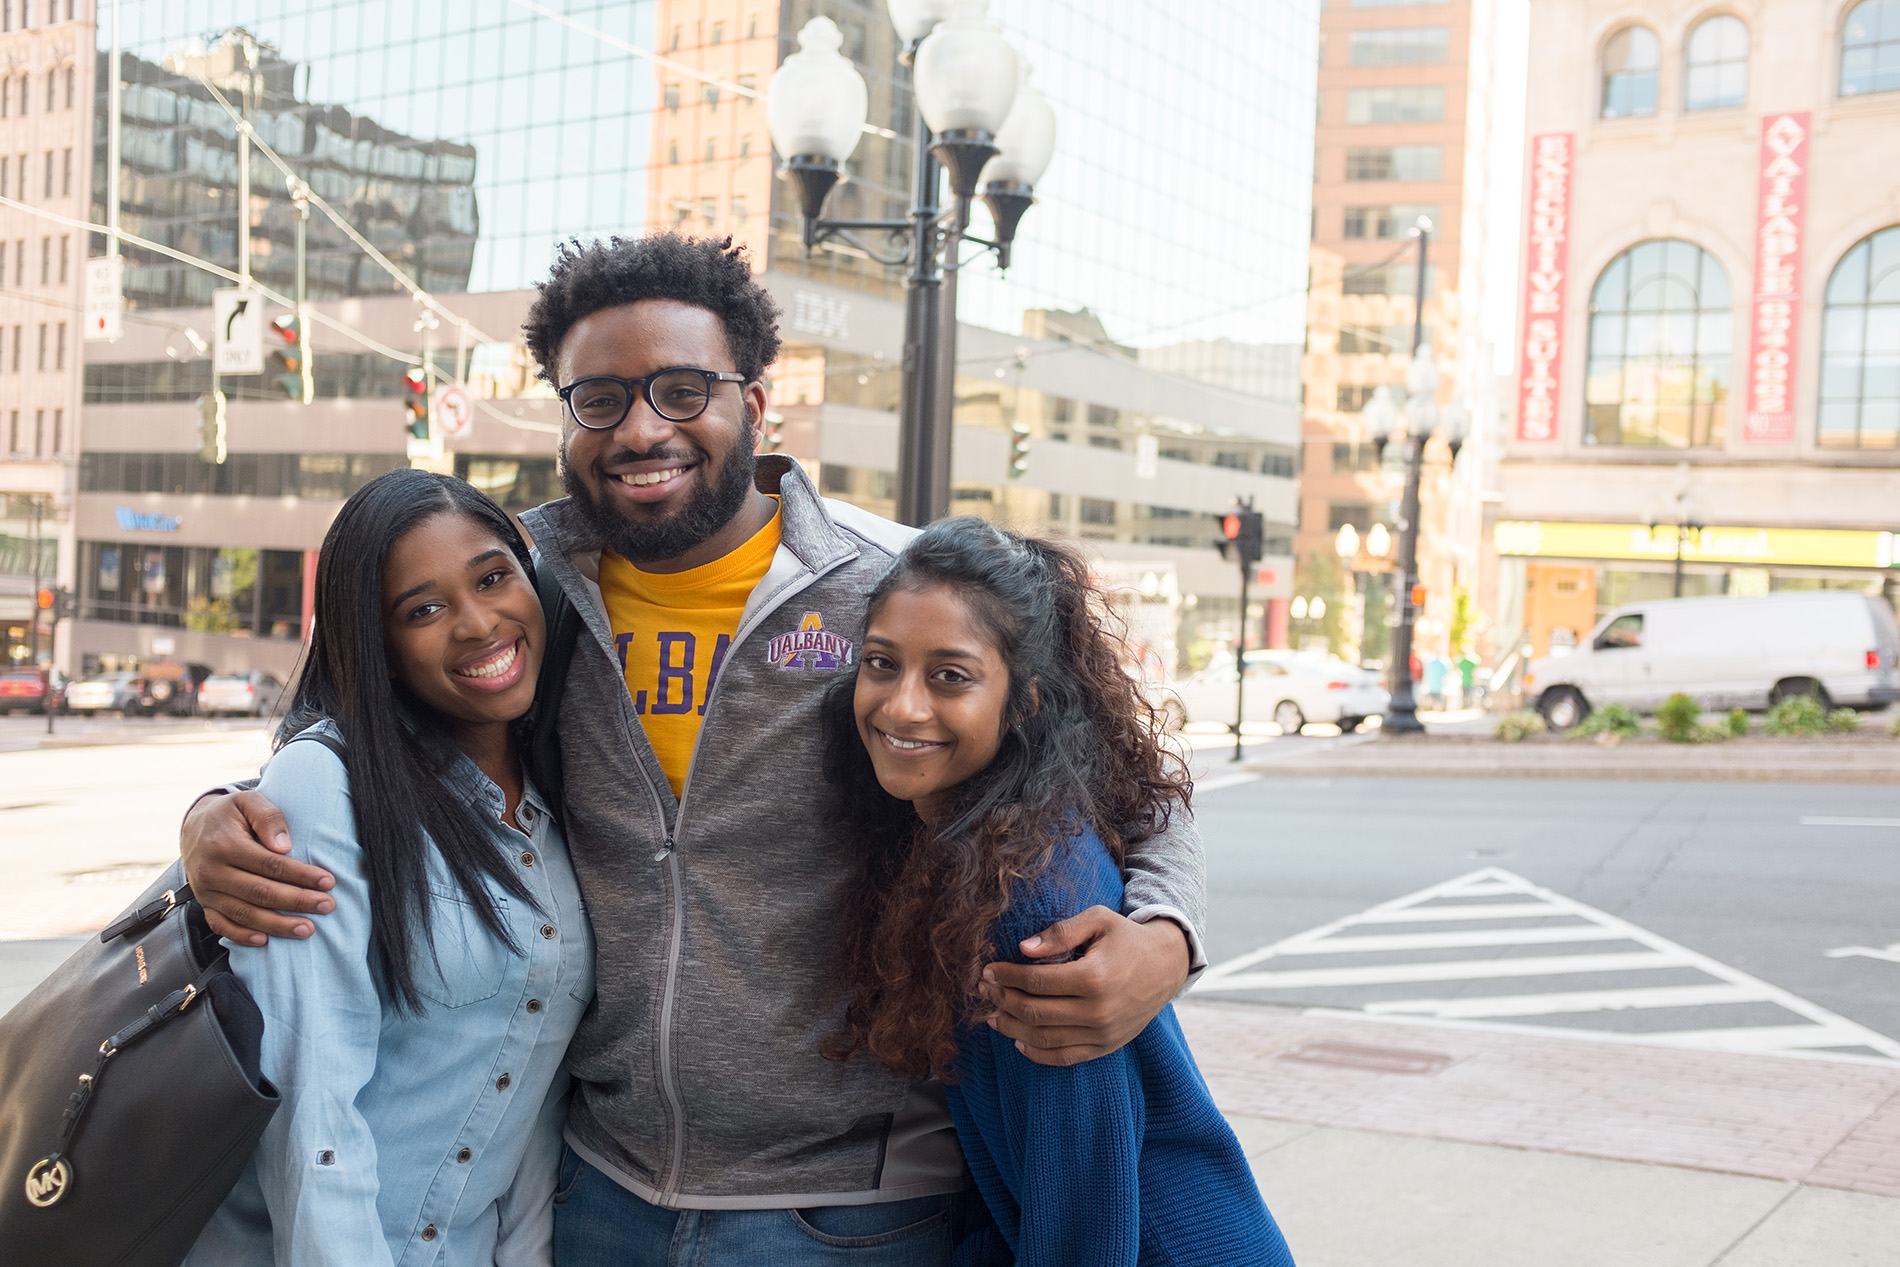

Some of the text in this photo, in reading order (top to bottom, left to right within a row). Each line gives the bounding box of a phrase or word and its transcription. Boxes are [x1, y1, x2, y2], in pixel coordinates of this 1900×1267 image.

[1761, 115, 1805, 293] AVAILABLE
[1523, 136, 1568, 439] EXECUTIVE SUITES
[793, 289, 850, 340] IBM
[769, 632, 852, 664] UALBANY
[30, 1167, 63, 1198] MK
